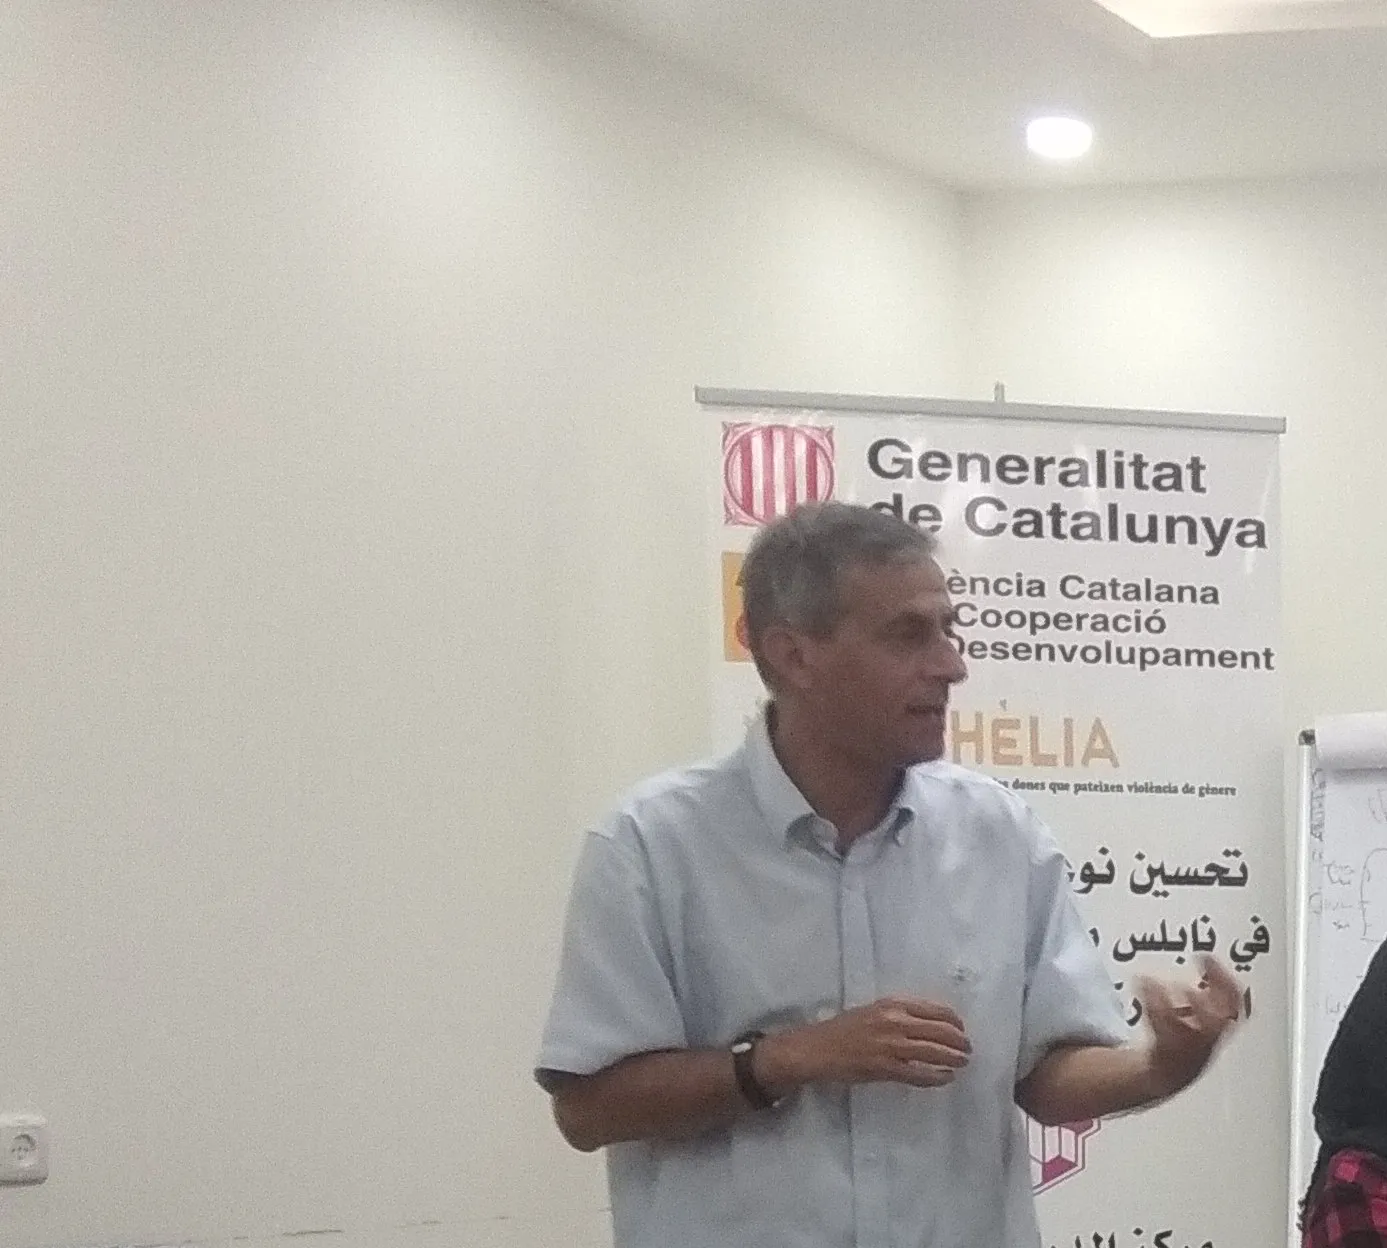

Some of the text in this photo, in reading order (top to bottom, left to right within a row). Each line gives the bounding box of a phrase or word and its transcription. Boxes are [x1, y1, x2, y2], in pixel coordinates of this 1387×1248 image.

[867, 437, 1207, 495] Generalitat
[964, 496, 1268, 557] Catalunya
[1059, 574, 1220, 605] Catalana
[953, 602, 1167, 636] Cooperació
[1049, 781, 1070, 795] que
[1182, 784, 1197, 796] de
[1065, 846, 1249, 898] تحسين نو
[1112, 914, 1217, 965] نابلس
[1229, 915, 1271, 973] في
